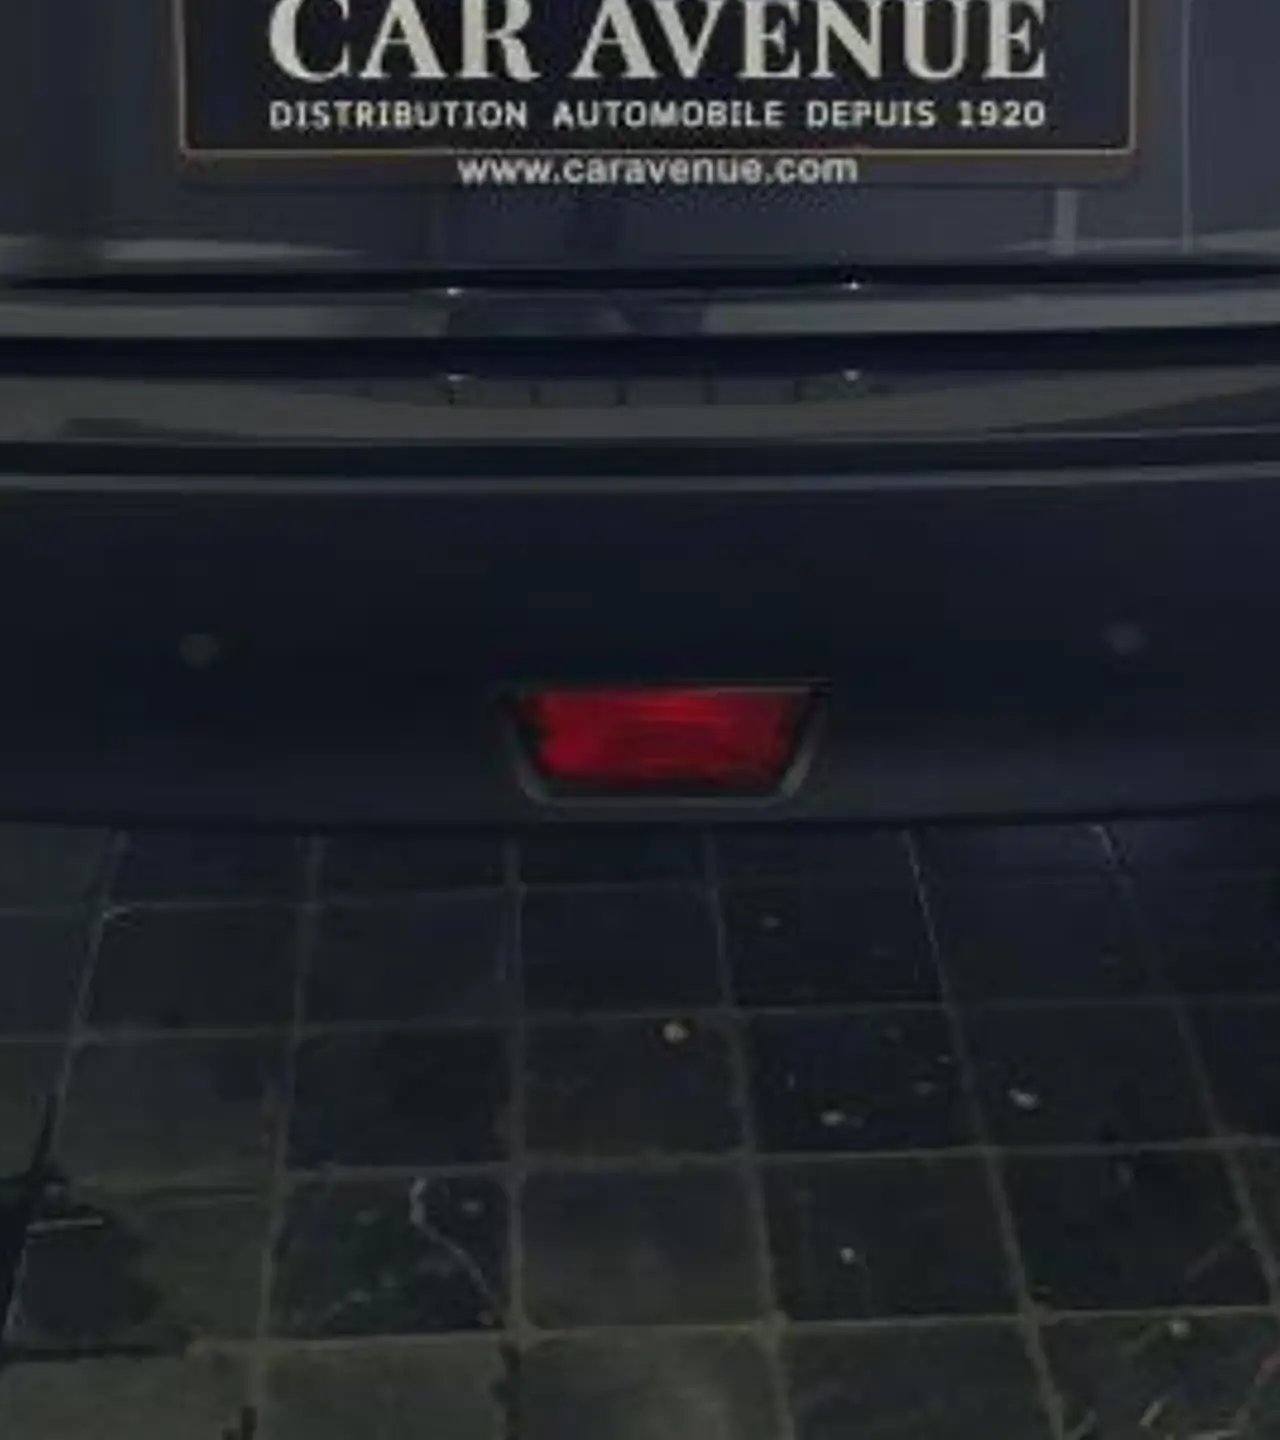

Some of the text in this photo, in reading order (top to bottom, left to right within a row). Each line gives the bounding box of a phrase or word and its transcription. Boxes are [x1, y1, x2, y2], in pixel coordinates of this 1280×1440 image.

[269, 99, 1047, 130] DISTRIBUTION AUTOMOBILE DEPUIS 1920
[457, 155, 859, 186] www.caravenue.com
